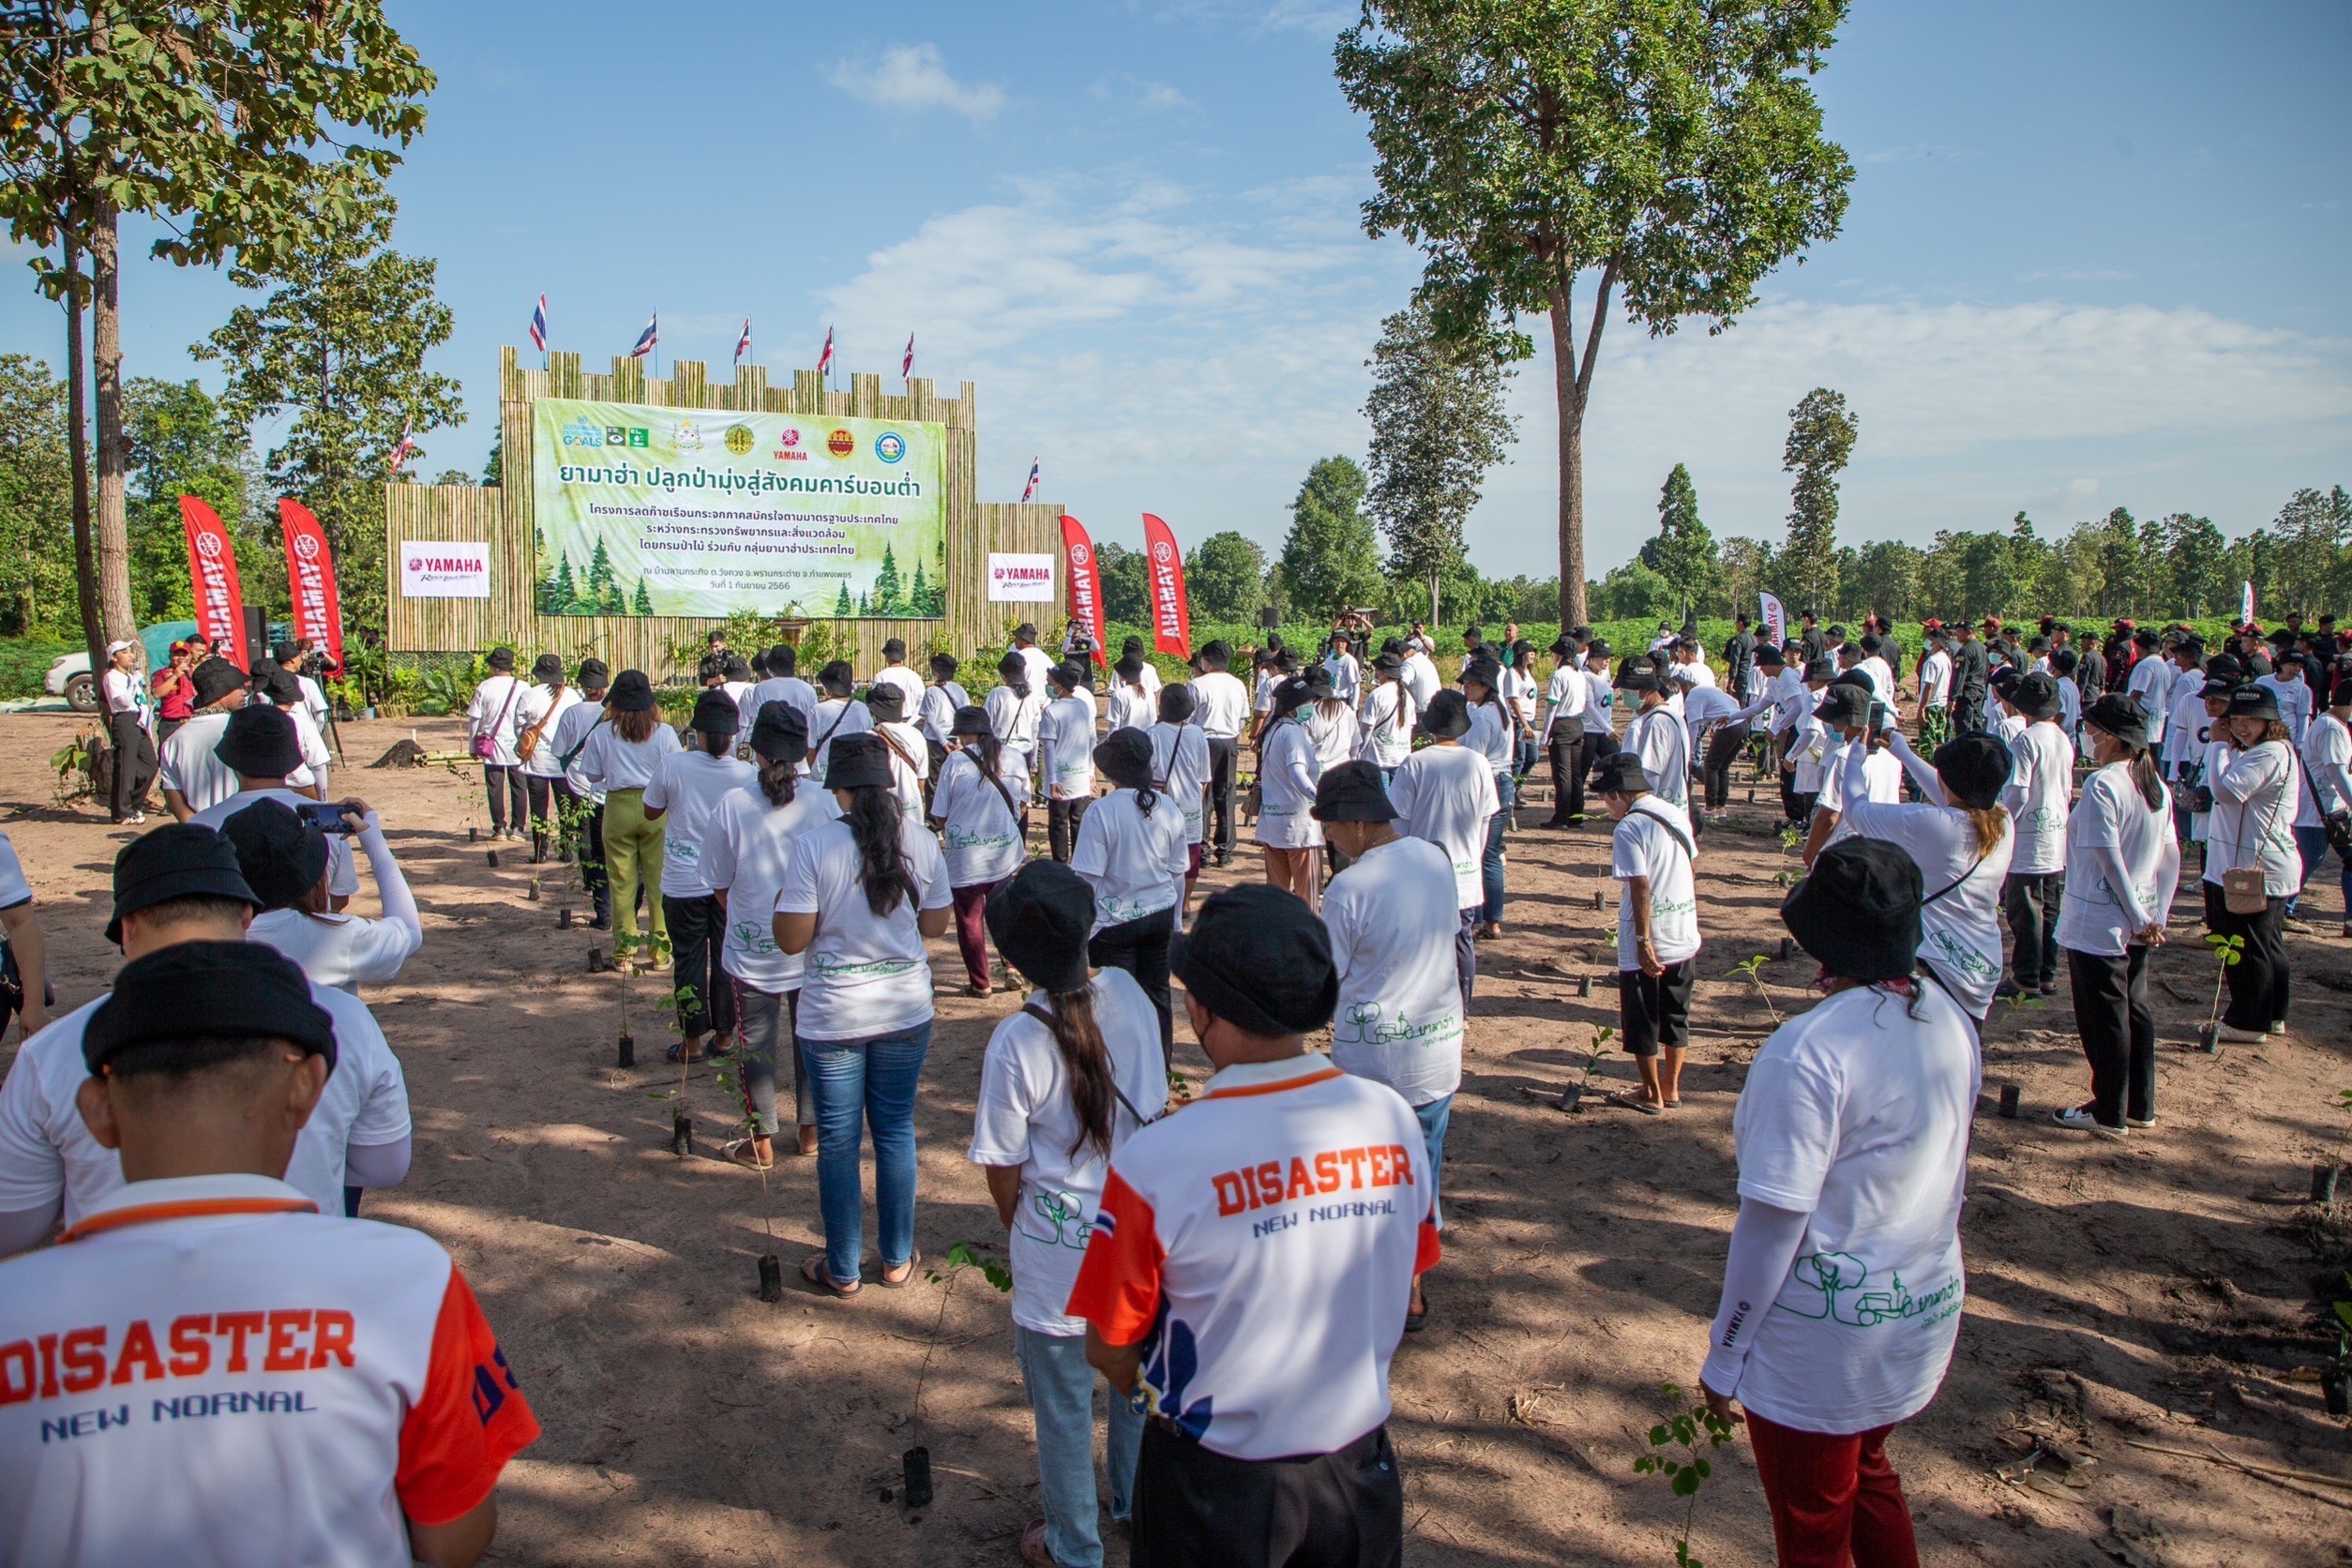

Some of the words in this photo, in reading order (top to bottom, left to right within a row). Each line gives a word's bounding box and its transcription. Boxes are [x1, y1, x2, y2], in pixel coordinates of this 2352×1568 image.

[774, 451, 807, 461] YAMAHA
[560, 462, 639, 485] ยามาฮ่า
[647, 466, 920, 496] ปลูกป่ามุ่งสู่สังคมคาร์บอนต่ำ
[590, 504, 898, 525] โครงการลดก๊าซเรือนกระจกภาคสมัครใจตามมาตรฐานประเทศไทย
[646, 523, 846, 539] ระหว่างกระทรวงทรัพยากรและสิ่งแวดล้อม
[640, 538, 704, 551] โดยกรมป่าไม้
[707, 540, 742, 552] ร่วมกับ
[745, 542, 855, 556] กลุ่มยามาฮ่าประเทศไทย
[425, 558, 483, 572] YAMAHA
[1006, 567, 1049, 580] YAMAHA
[710, 579, 727, 589] วันที่
[735, 580, 766, 590] กันยายน
[768, 581, 791, 590] 2566
[1211, 1144, 1414, 1216] DISASTER
[1253, 1213, 1299, 1239] NEW
[1722, 1310, 1747, 1348] YAMAHA
[0, 1308, 355, 1405] DISASTER
[40, 1405, 129, 1443] NEW
